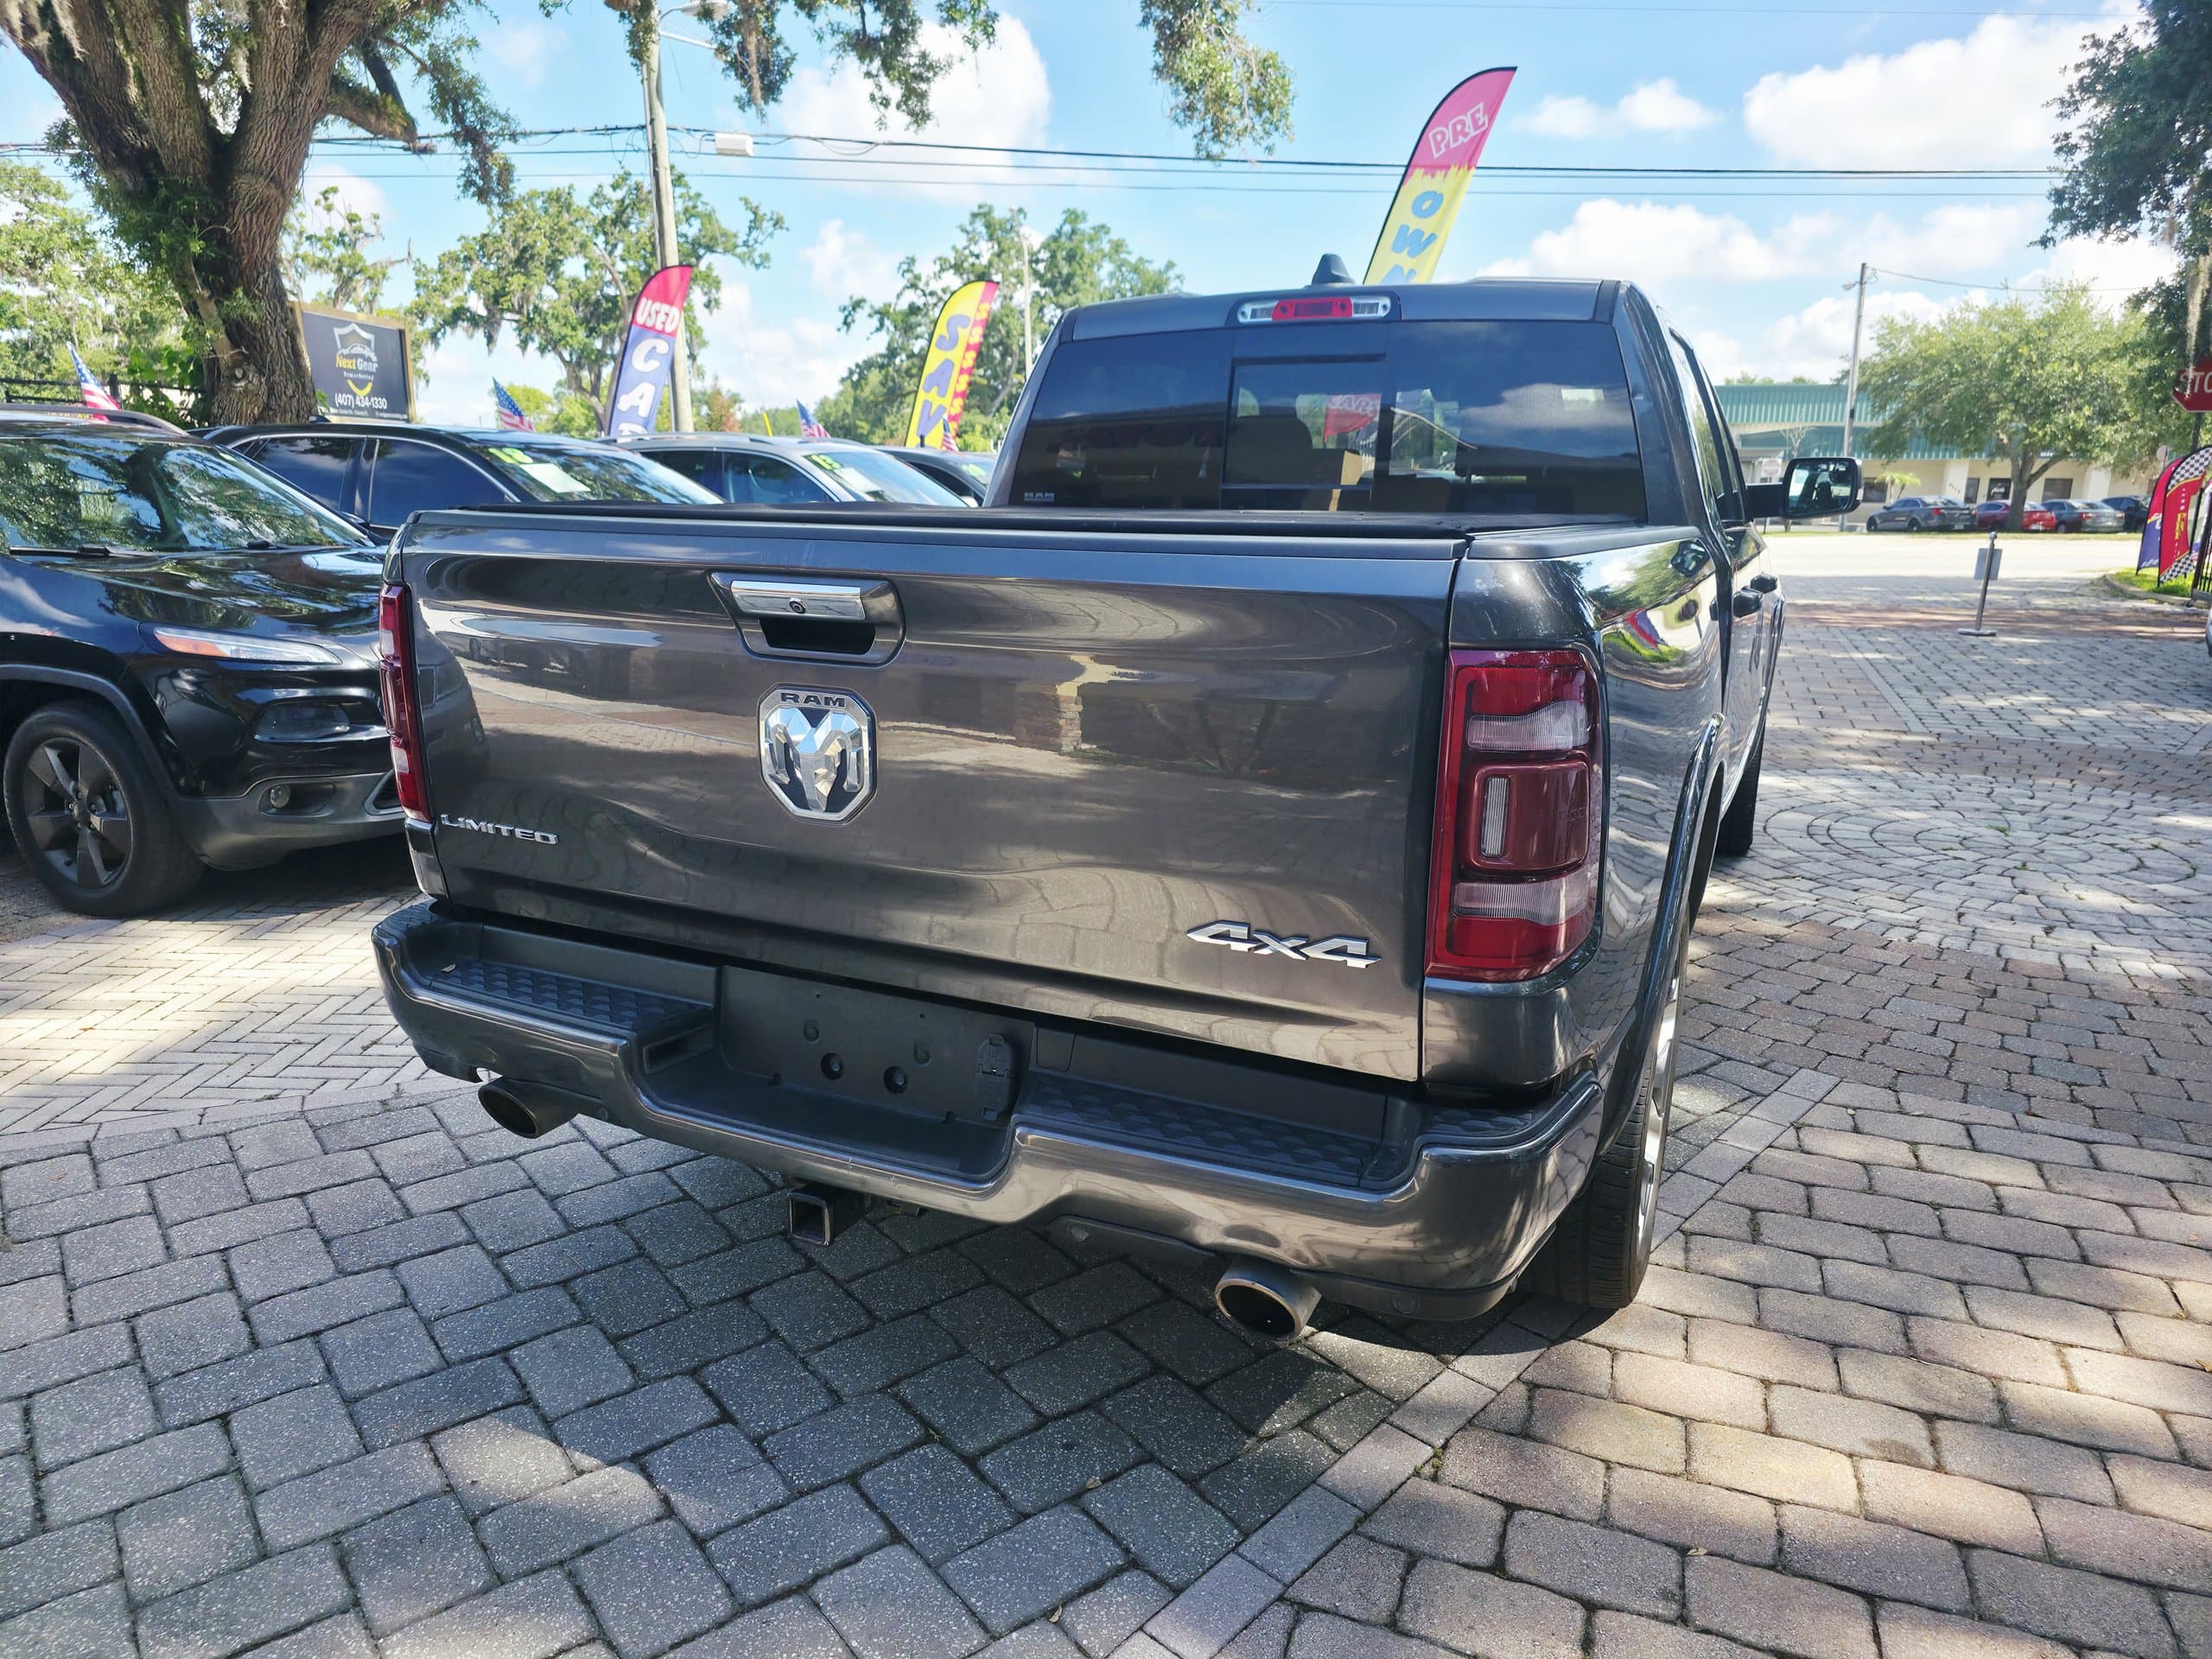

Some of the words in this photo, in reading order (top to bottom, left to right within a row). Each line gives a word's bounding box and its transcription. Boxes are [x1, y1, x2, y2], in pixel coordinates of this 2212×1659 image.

[1428, 101, 1489, 159] PRE
[635, 297, 681, 334] USED
[336, 353, 356, 370] Next
[357, 358, 378, 372] Gear
[917, 314, 971, 448] SAV
[334, 393, 354, 409] (407)
[355, 395, 388, 410] 434-1330
[780, 692, 846, 708] RAM
[440, 813, 558, 845] LIMITED
